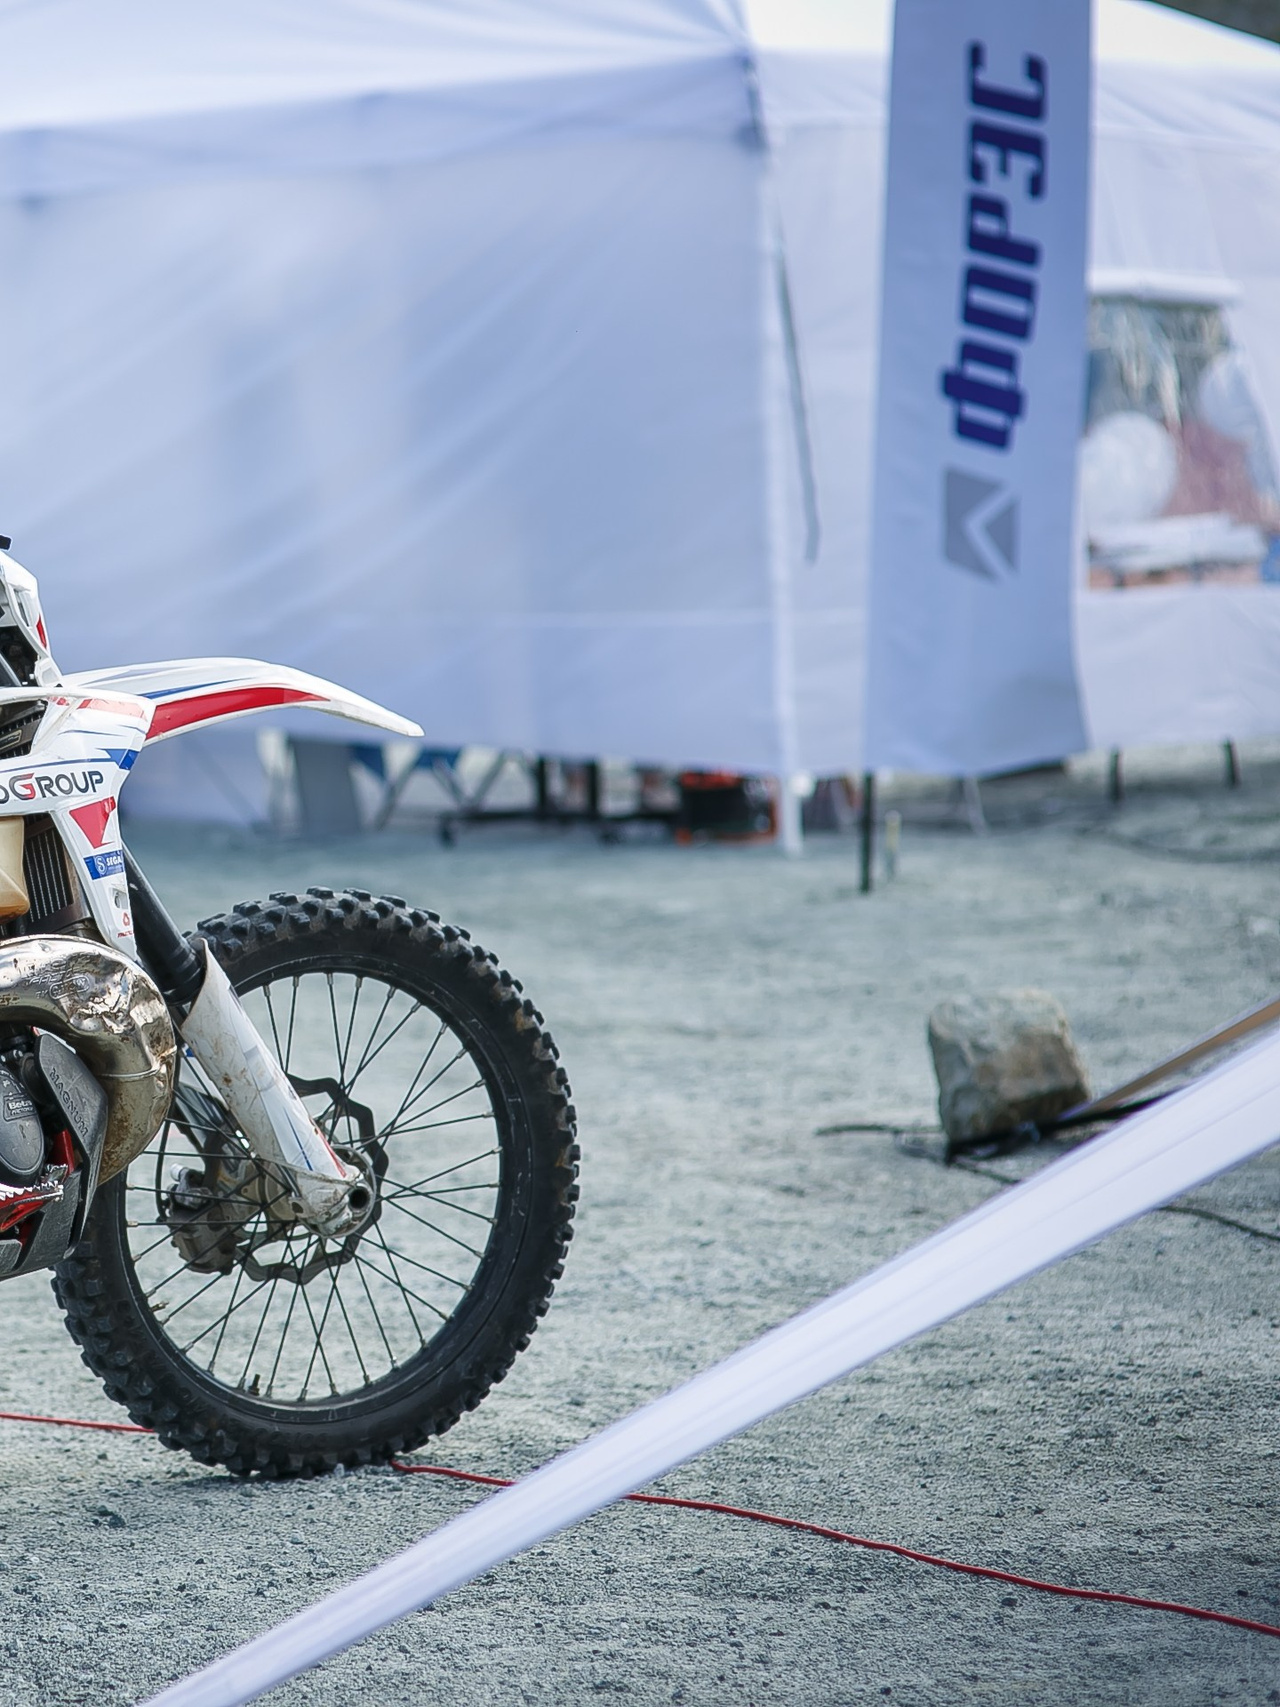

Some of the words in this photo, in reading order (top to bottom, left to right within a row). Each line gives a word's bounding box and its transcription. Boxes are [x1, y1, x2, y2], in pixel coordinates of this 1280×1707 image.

[940, 40, 1048, 453] ФОРЭС
[8, 1100, 33, 1110] Beta
[49, 1067, 89, 1137] MAGNUM
